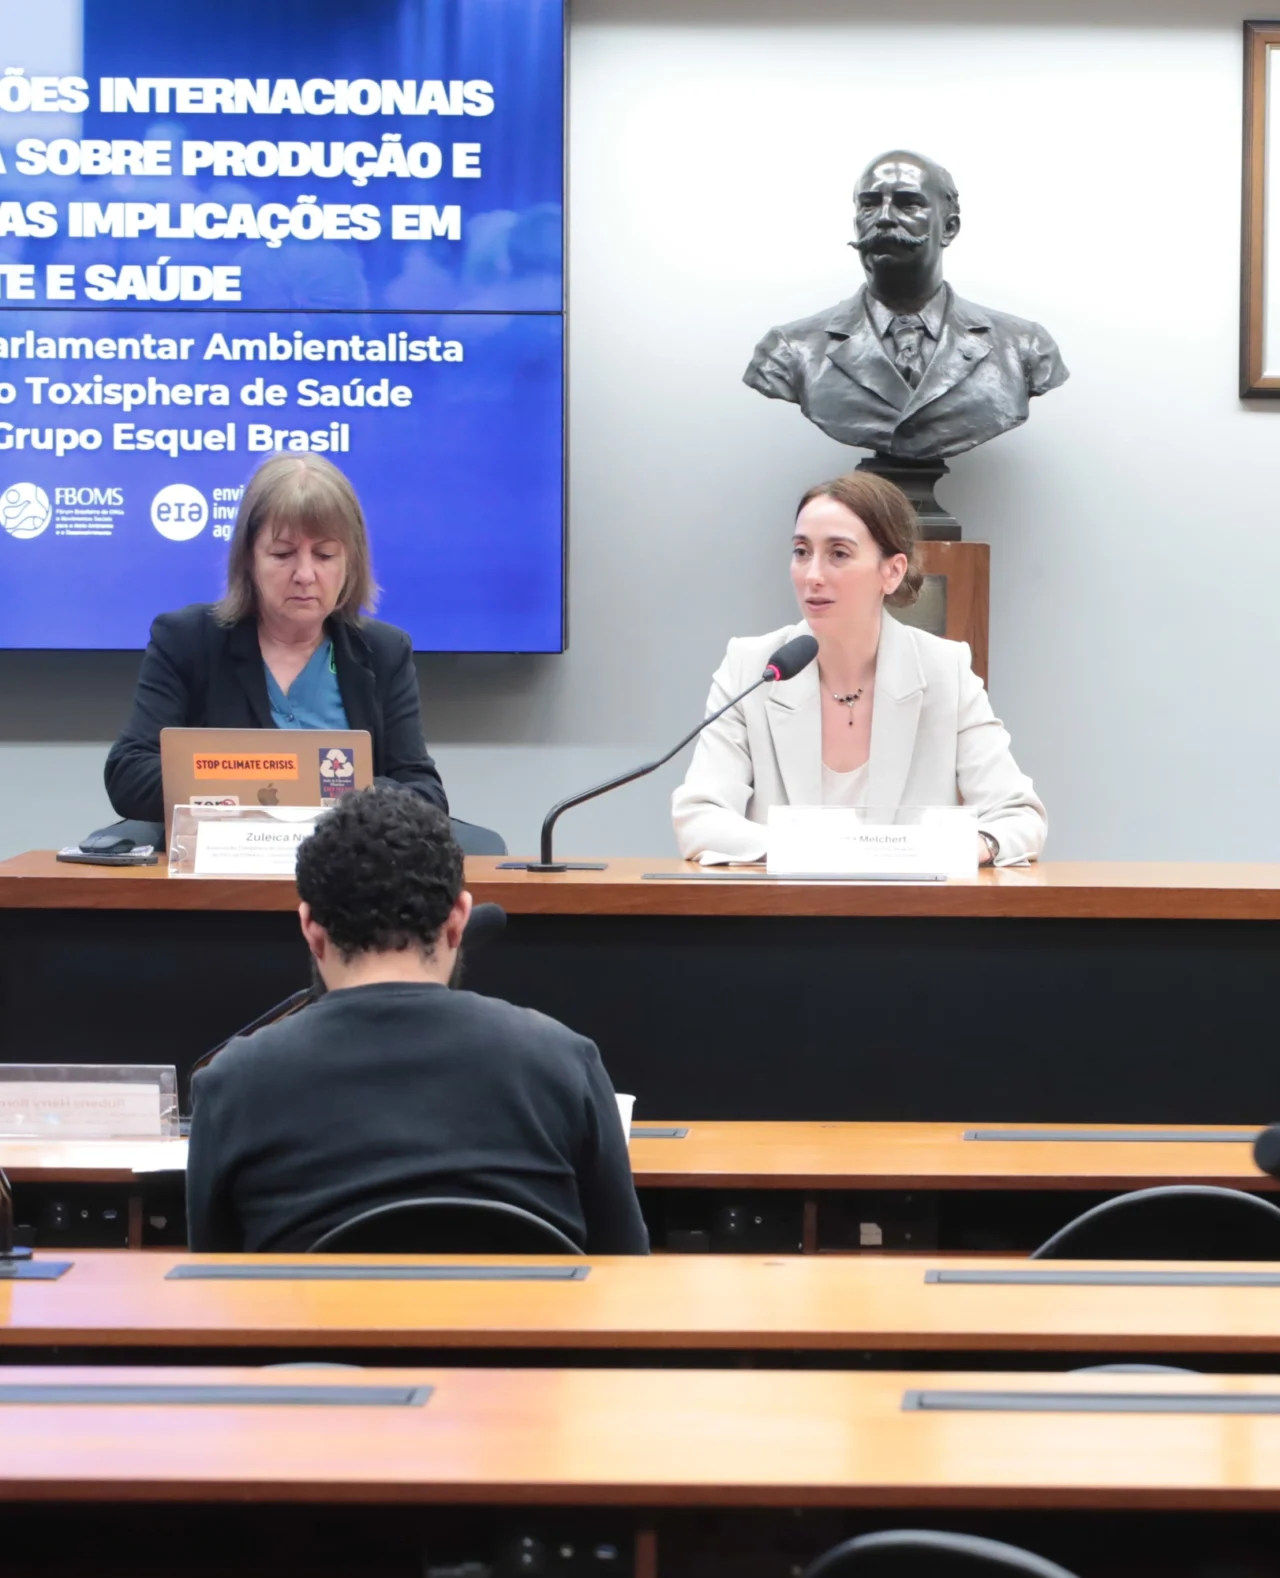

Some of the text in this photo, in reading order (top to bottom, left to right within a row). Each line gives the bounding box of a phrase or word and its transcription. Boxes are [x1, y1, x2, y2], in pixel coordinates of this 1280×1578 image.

[100, 77, 495, 116] INTERNACIONAIS
[15, 138, 172, 176] SOBRE
[182, 133, 442, 187] PRODUÇÃO
[453, 143, 481, 178] E
[68, 195, 380, 248] IMPLICAÇÕES
[392, 204, 461, 240] EM
[46, 264, 76, 300] E
[84, 256, 242, 301] SAÚDE
[204, 331, 464, 363] Ambientalista
[24, 374, 230, 412] Toxisphera
[240, 377, 288, 406] de
[297, 379, 413, 407] Saúde
[113, 423, 236, 458] Esquel
[248, 423, 350, 453] Brasil
[54, 487, 124, 506] FBOMS
[196, 760, 220, 770] STOP
[221, 760, 262, 770] CLIMATE
[245, 832, 290, 843] Zuleica
